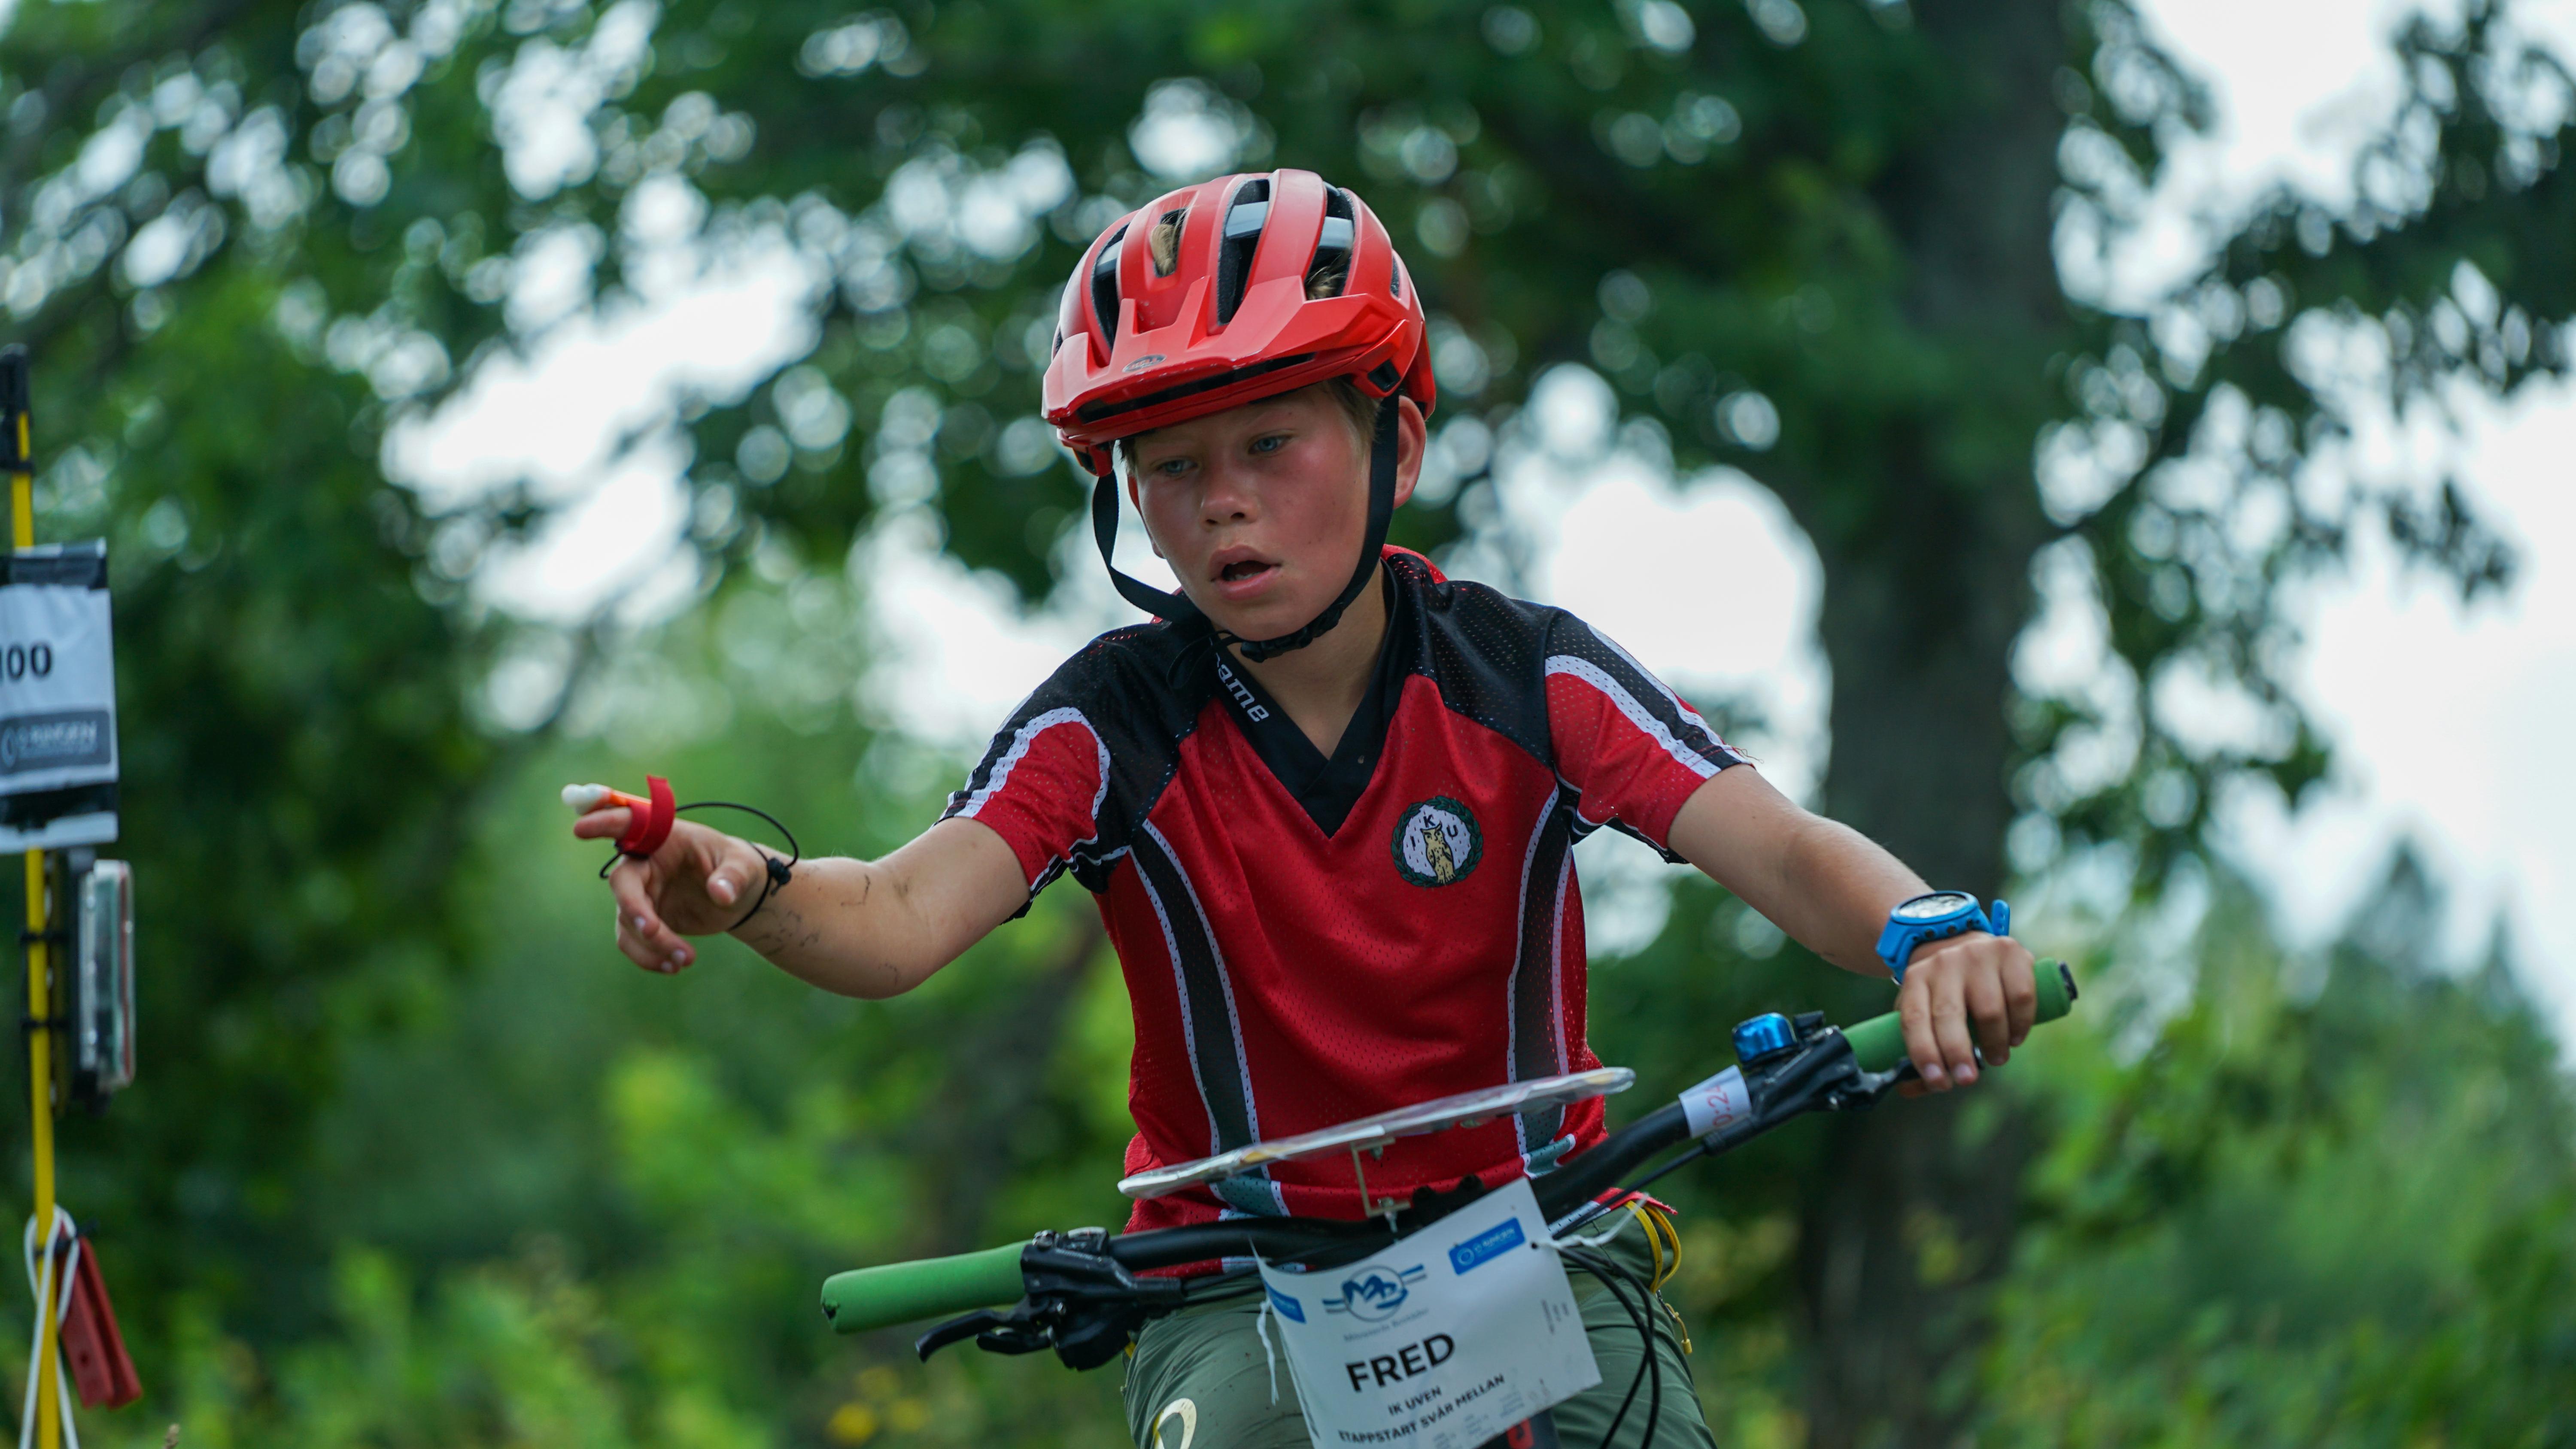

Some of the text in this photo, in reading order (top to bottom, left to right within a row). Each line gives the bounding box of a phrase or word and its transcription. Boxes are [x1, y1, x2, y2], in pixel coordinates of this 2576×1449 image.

[1345, 1333, 1455, 1393] FRED
[1338, 1420, 1417, 1444] ETAPPSTART
[1420, 1402, 1454, 1428] SVÅR
[1455, 1373, 1506, 1408] MELLAN
[1388, 1385, 1442, 1416] IK UVEN
